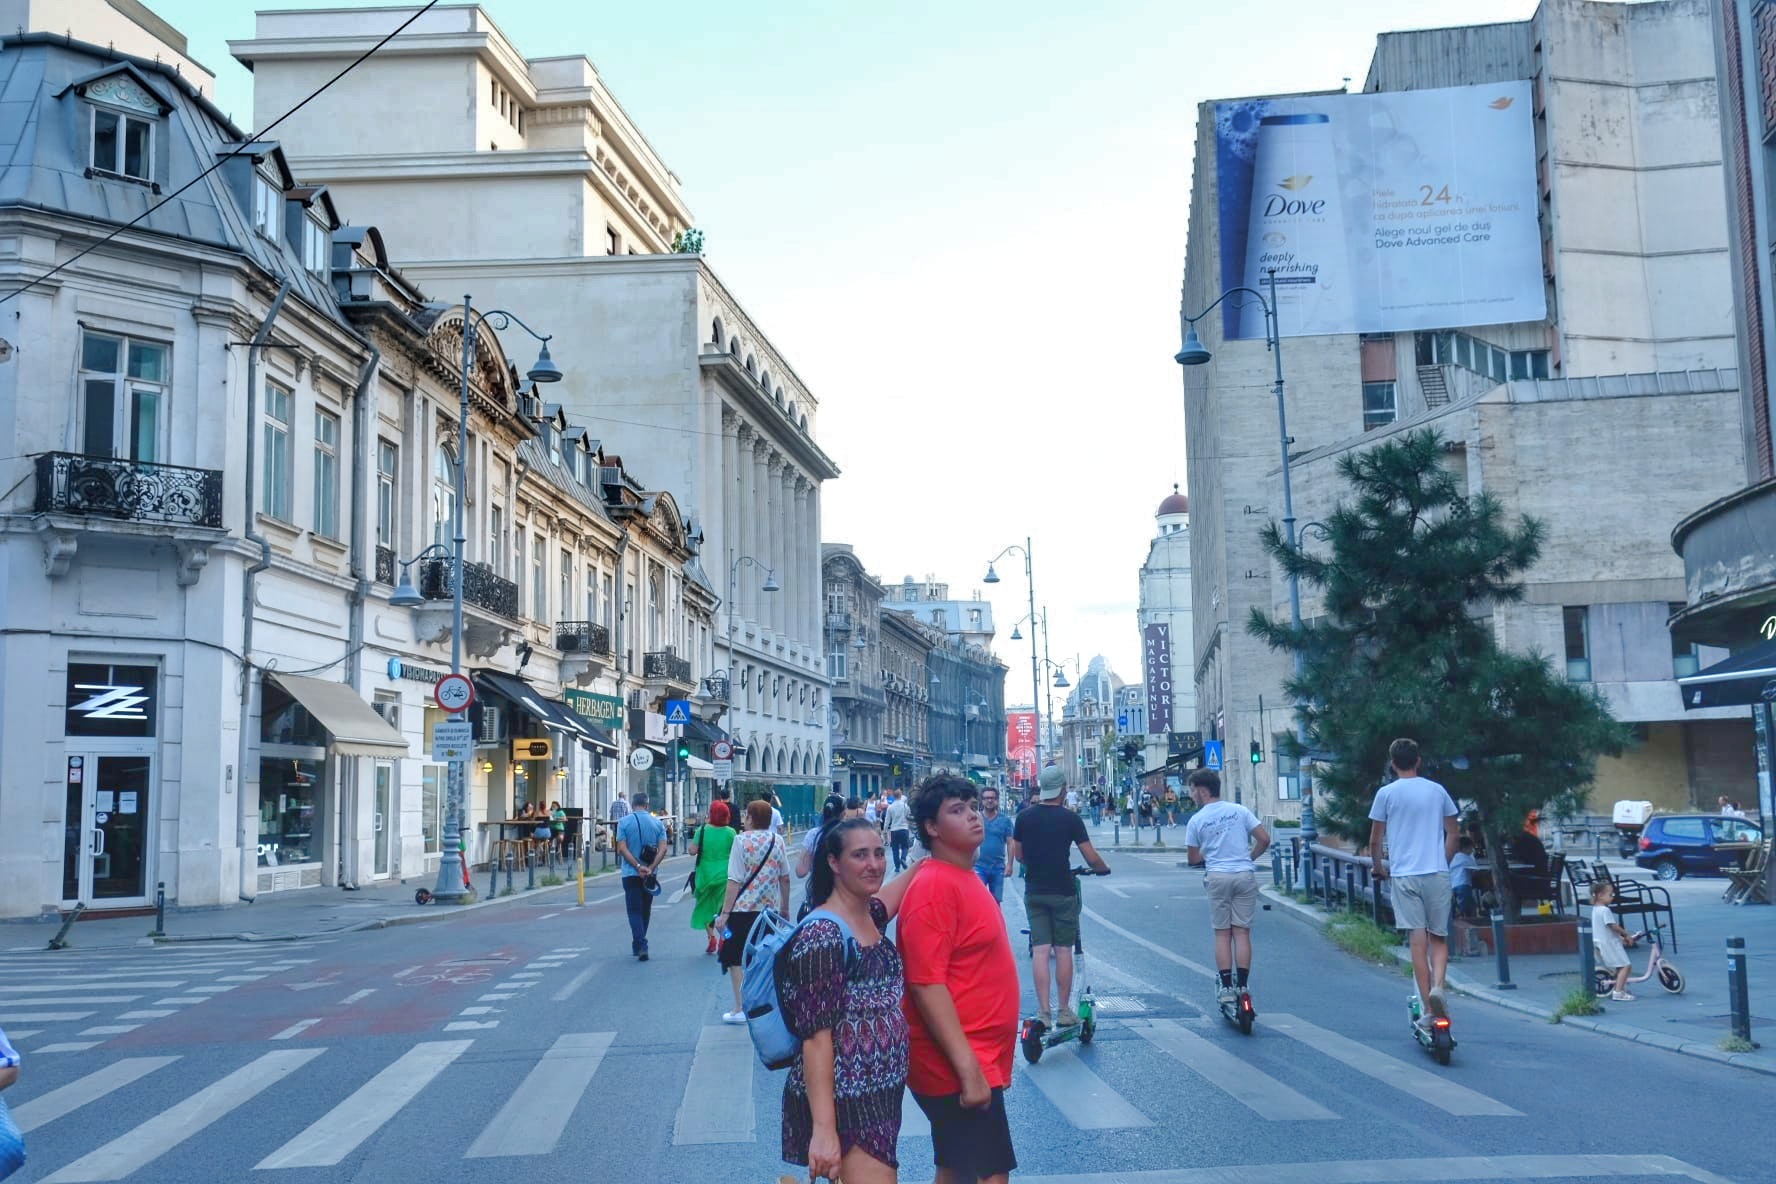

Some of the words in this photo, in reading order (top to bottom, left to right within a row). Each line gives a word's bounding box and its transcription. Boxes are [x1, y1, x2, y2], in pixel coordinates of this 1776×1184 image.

[1419, 184, 1452, 206] 24
[1264, 193, 1326, 217] Dove
[1416, 207, 1463, 219] aplicarea
[1465, 205, 1486, 215] unei
[1375, 227, 1405, 239] Alege
[1408, 225, 1431, 236] noul
[1434, 223, 1451, 236] gel
[1454, 222, 1469, 231] de
[1375, 238, 1404, 248] Dove
[1406, 234, 1460, 247] Advanced
[1463, 232, 1491, 243] Care
[1259, 251, 1295, 264] deeply
[1259, 262, 1319, 275] nourishing
[1147, 639, 1158, 721] MAGAZINUL
[1158, 626, 1172, 732] VICTORIA
[576, 696, 615, 719] HERBAGEN
